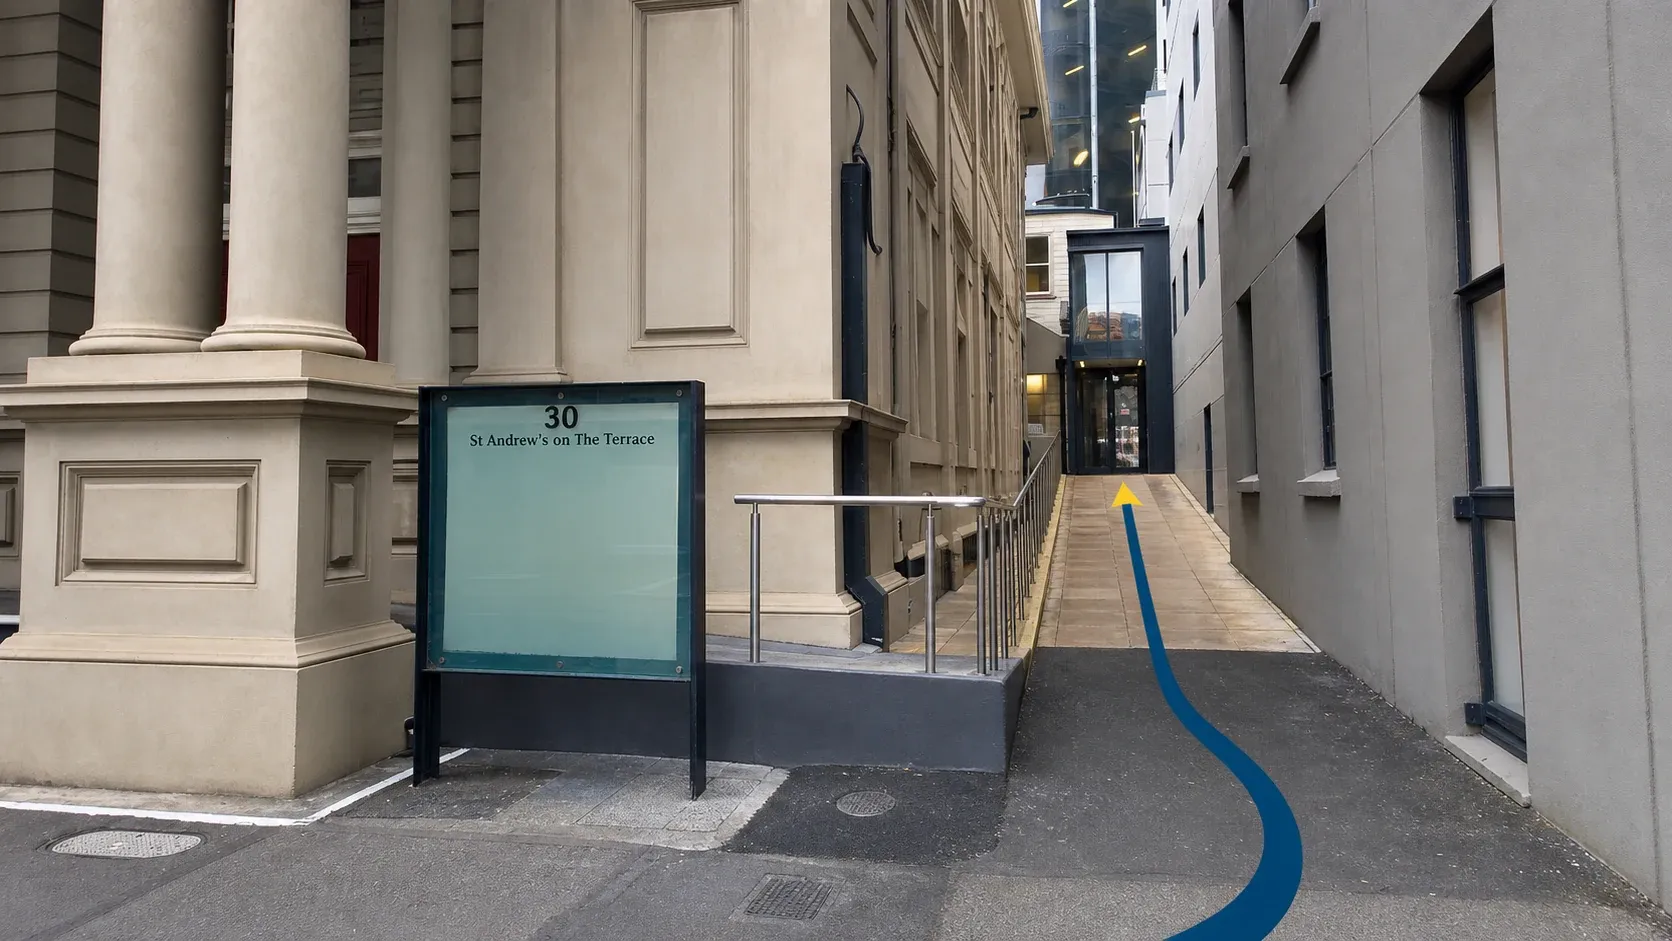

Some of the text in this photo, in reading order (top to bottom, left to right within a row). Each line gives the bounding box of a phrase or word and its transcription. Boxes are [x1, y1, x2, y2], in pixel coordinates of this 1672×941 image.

[544, 405, 579, 429] 30
[469, 432, 655, 447] St Andrew's on The Terrace
